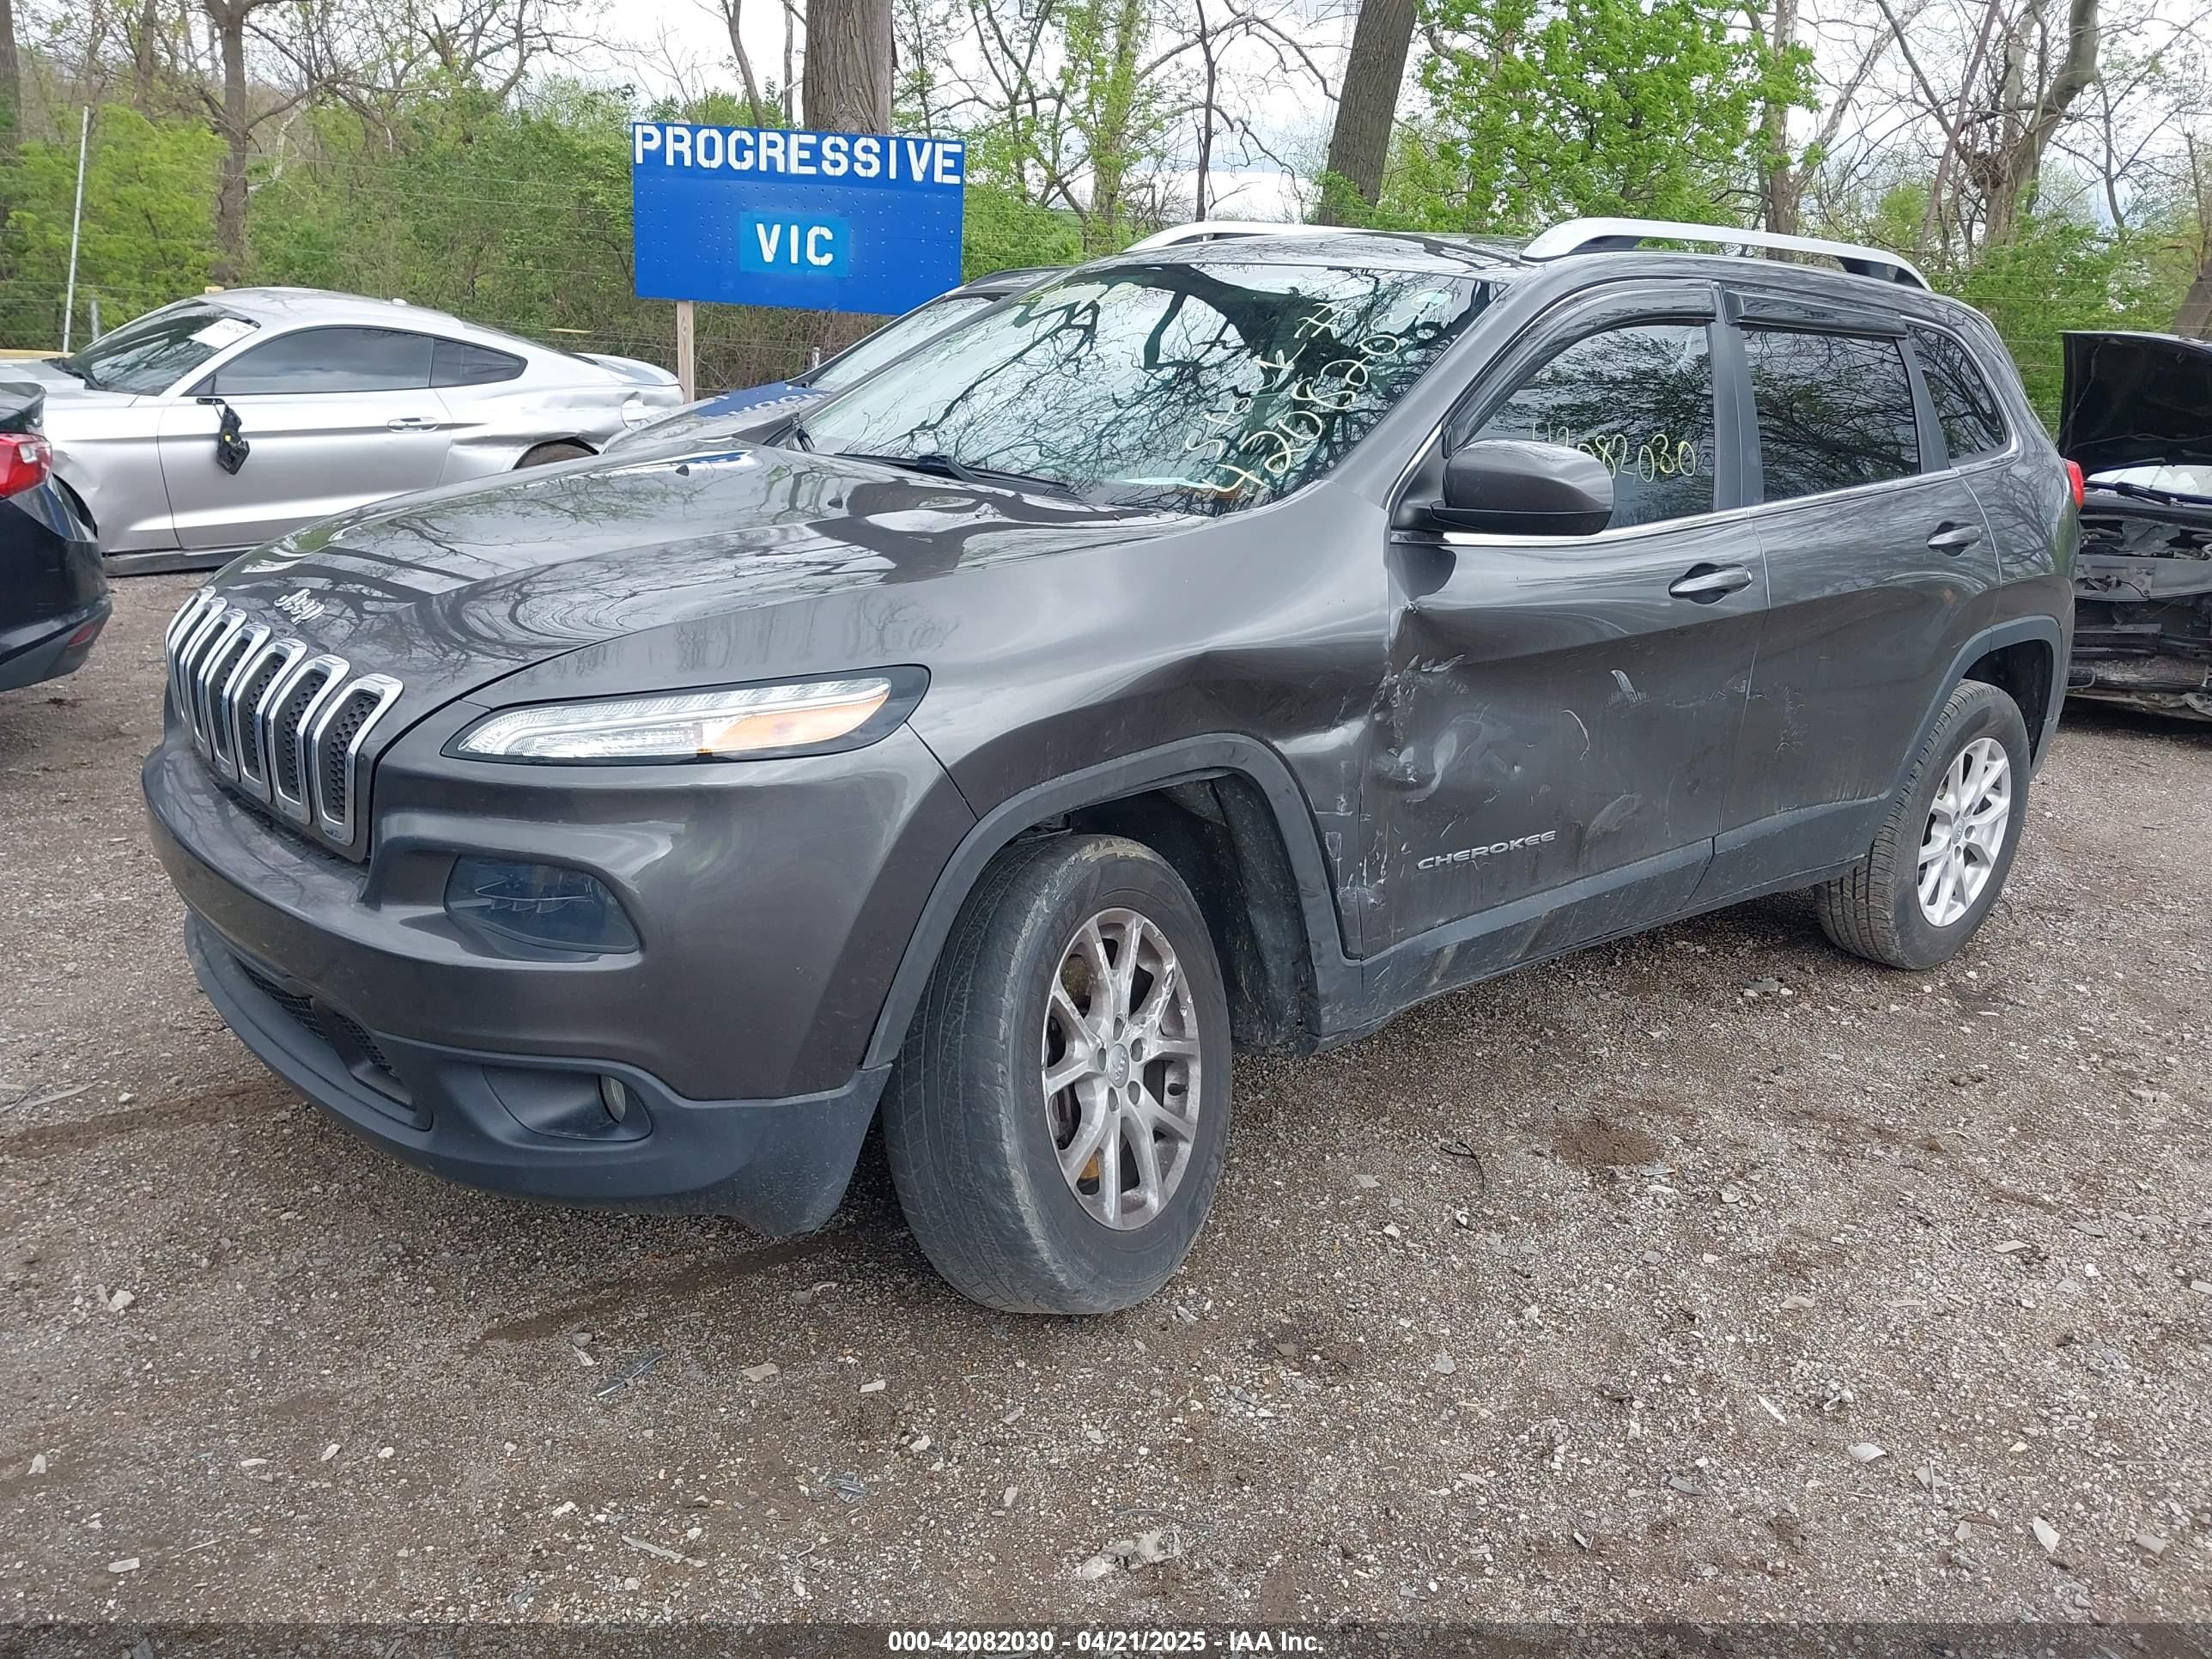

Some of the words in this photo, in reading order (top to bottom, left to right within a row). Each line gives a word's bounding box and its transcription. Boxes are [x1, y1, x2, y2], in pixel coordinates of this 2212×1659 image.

[634, 125, 963, 185] PROGRESSIVE
[756, 222, 834, 267] VIC
[1201, 288, 1451, 493] 42082030
[274, 587, 326, 626] Jeep
[1417, 830, 1557, 871] CHEROKEE
